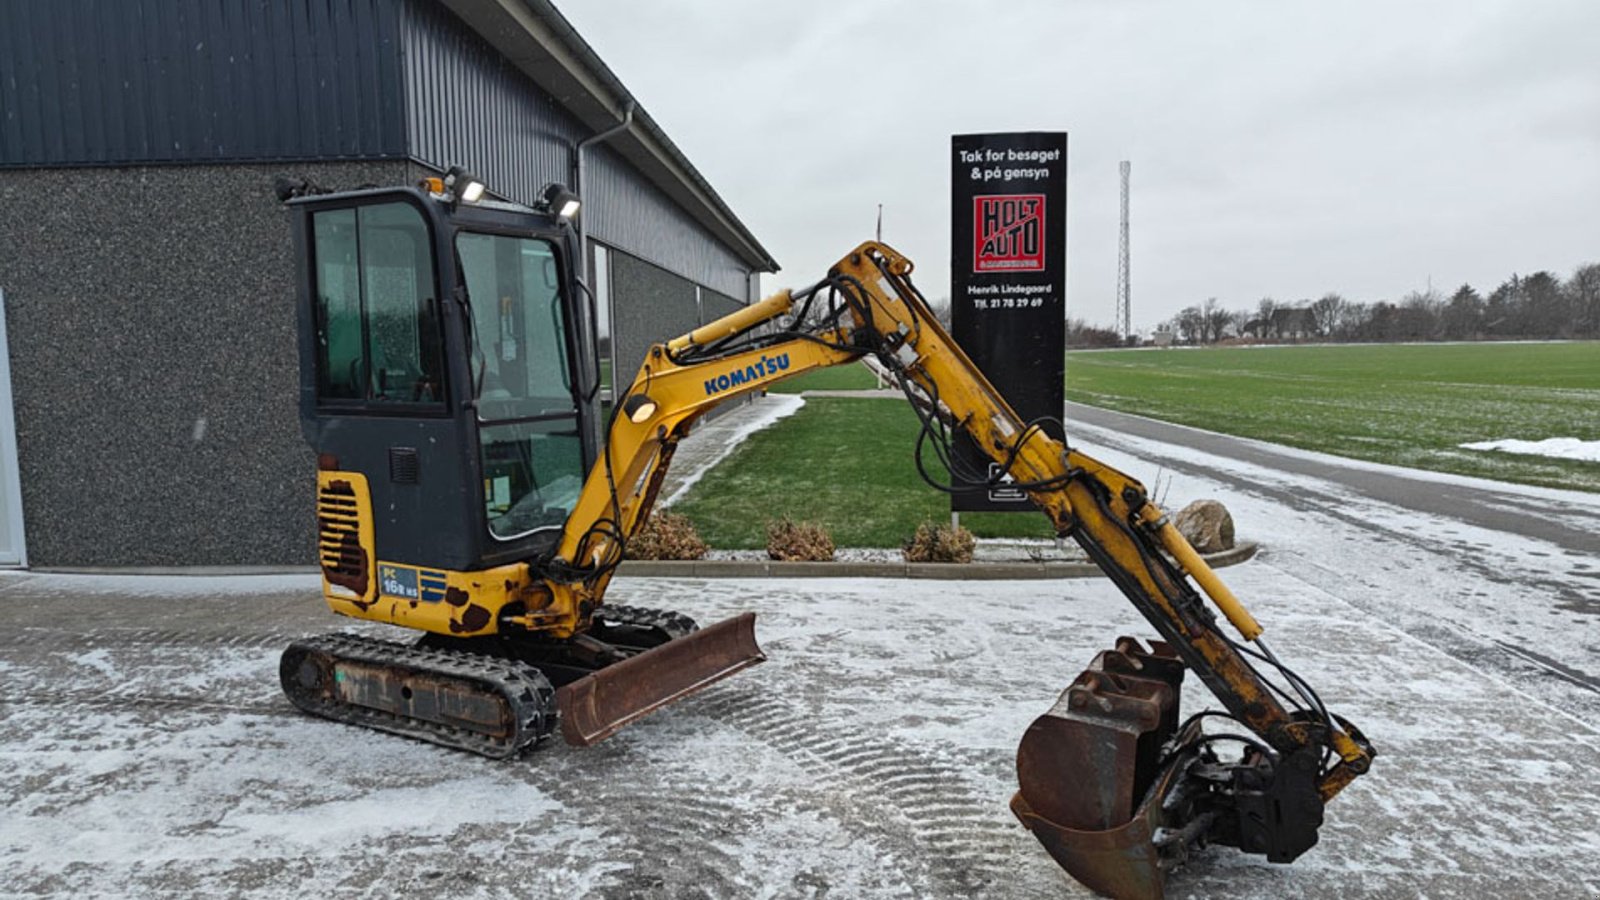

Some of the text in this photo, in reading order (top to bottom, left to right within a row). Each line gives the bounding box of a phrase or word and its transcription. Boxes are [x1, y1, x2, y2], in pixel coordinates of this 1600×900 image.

[960, 148, 1060, 163] Tak for besøget
[970, 166, 1049, 181] & på gensyn
[982, 200, 1039, 238] HOLT
[980, 217, 1039, 256] AUTO
[967, 283, 1052, 296] Henrik Lindegaard
[990, 299, 1000, 308] 21
[1003, 298, 1014, 308] 78
[1016, 298, 1029, 308] 29
[1030, 297, 1043, 308] 69
[704, 352, 790, 395] KOMATSU
[384, 568, 396, 579] PC
